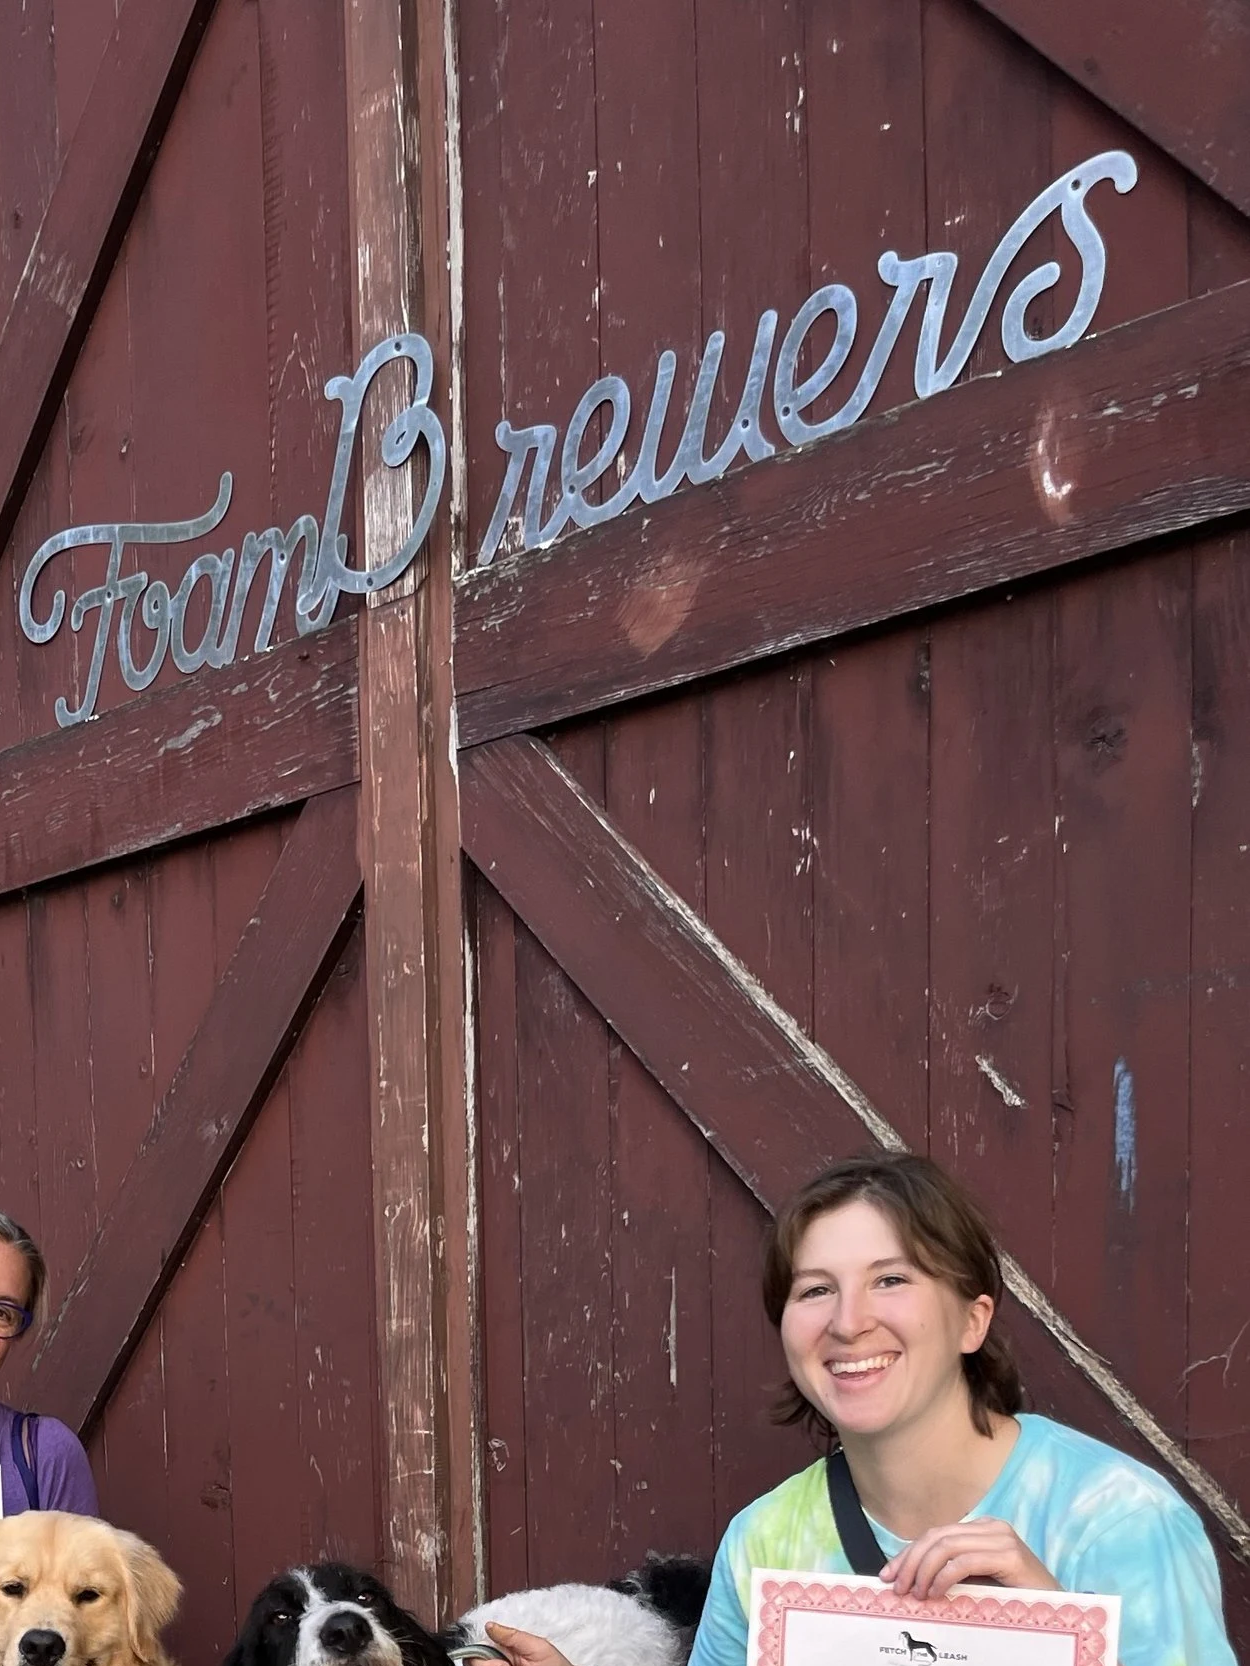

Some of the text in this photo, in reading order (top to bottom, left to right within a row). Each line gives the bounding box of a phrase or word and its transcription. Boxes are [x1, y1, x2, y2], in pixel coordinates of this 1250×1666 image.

[19, 150, 1138, 729] Foam Brewers
[879, 1646, 907, 1656] FETCH
[938, 1651, 968, 1661] LEASH
